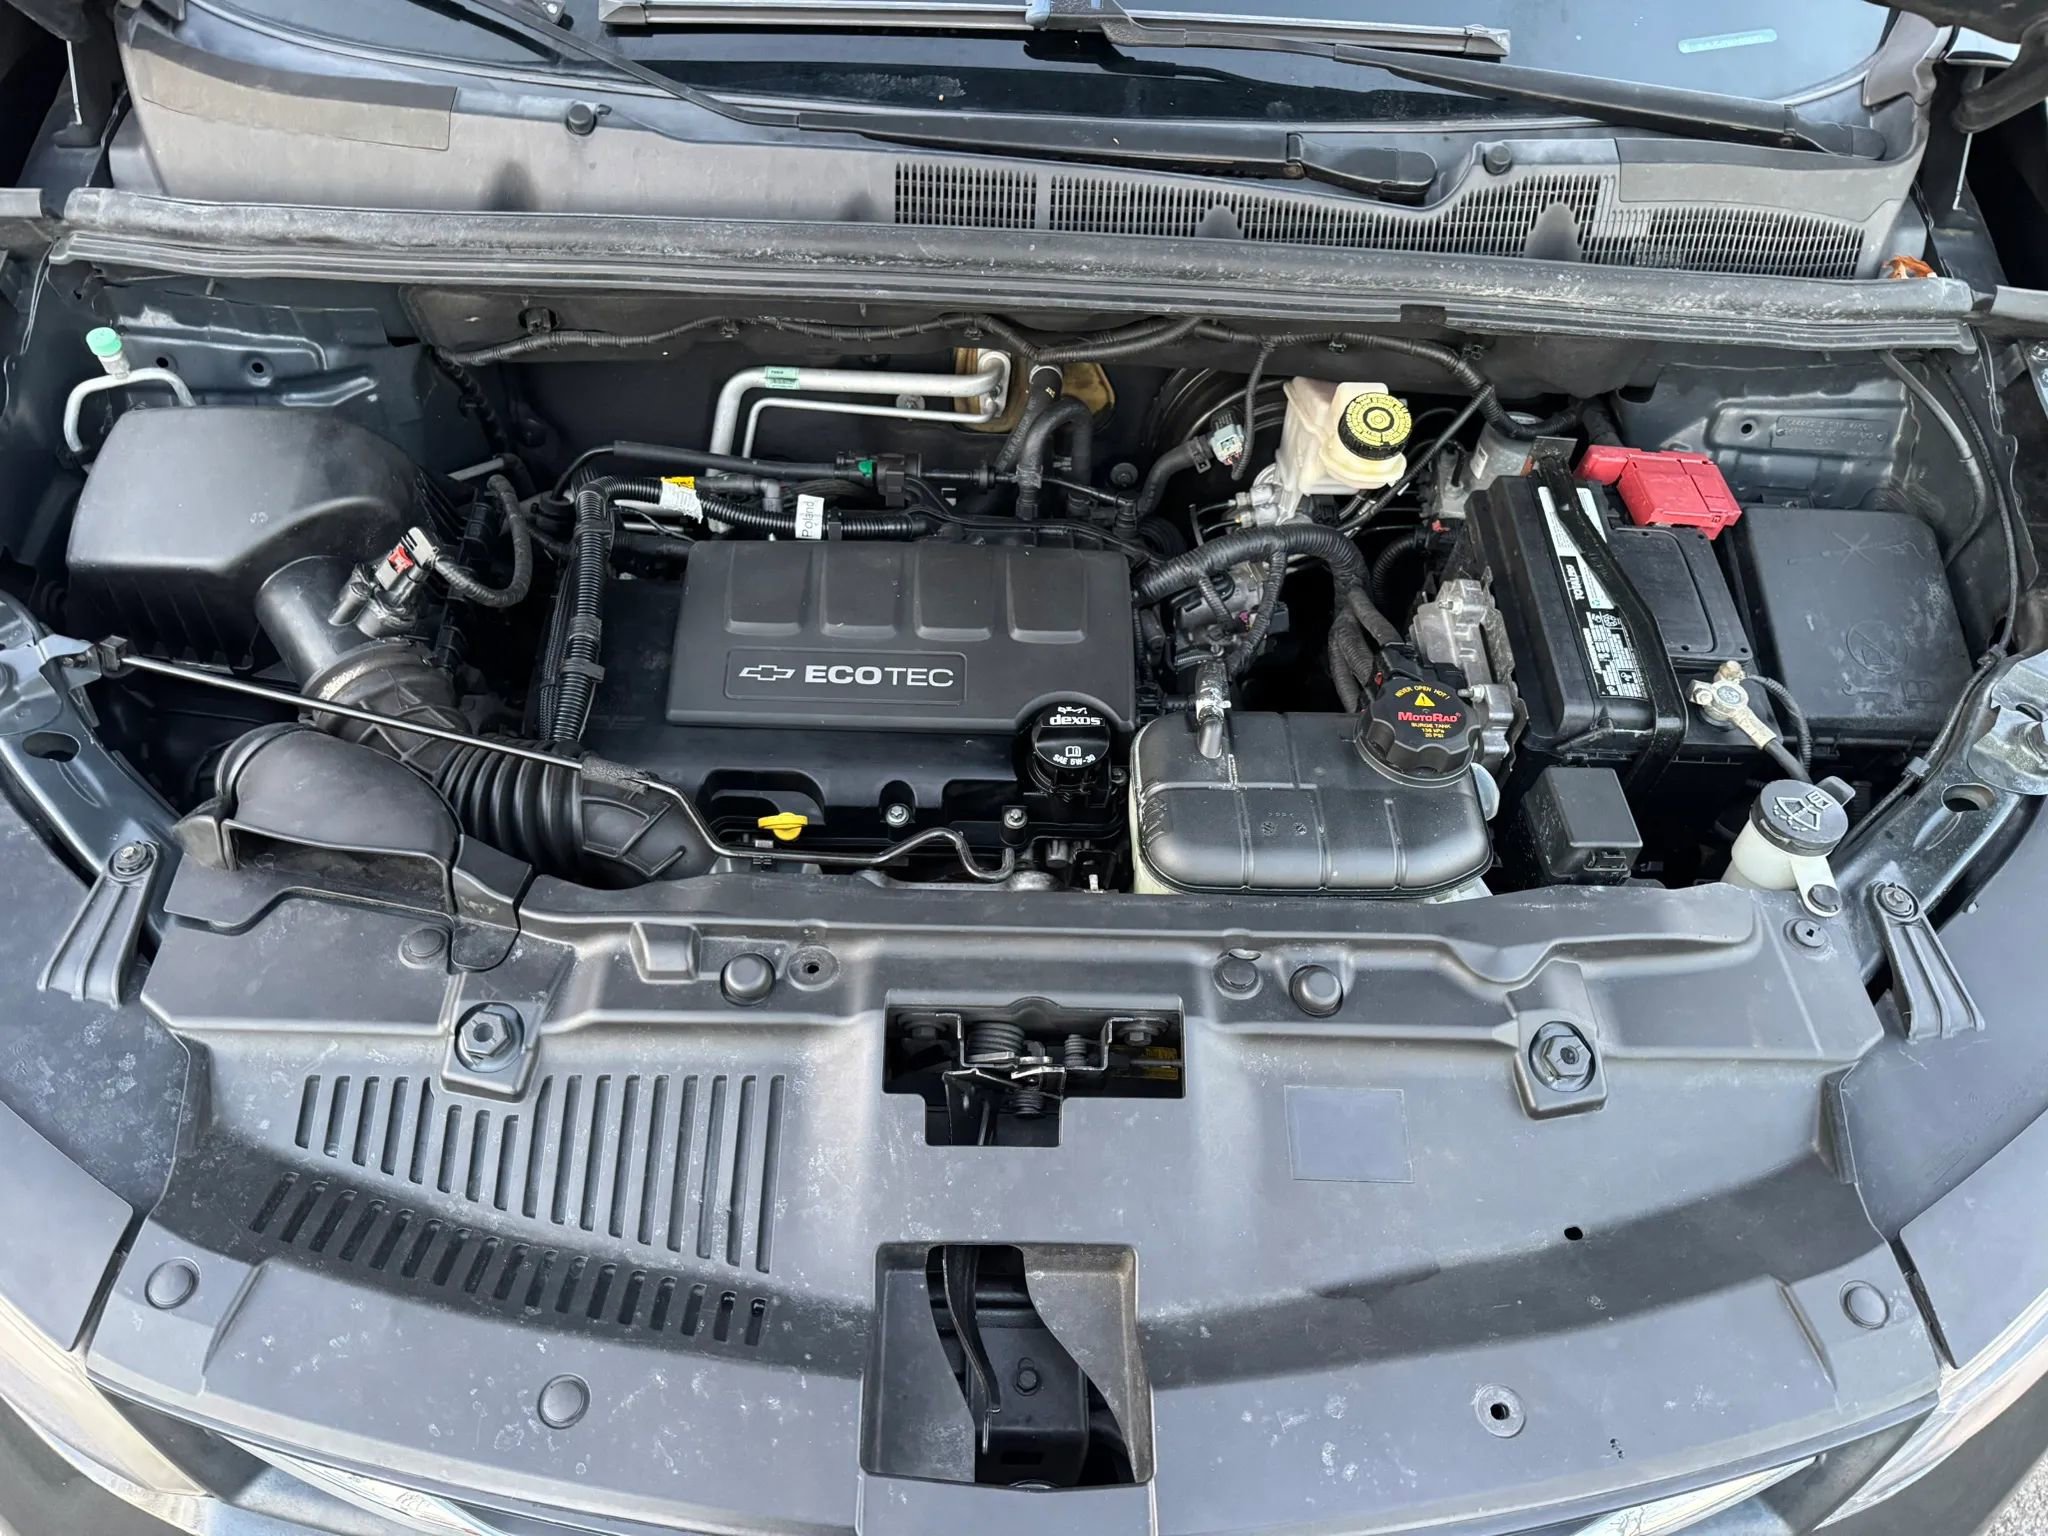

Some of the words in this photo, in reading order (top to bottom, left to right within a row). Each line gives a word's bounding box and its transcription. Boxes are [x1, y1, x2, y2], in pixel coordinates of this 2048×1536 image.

[801, 500, 815, 538] Poland
[804, 664, 954, 688] ECOTEC
[1050, 714, 1102, 725] dexos
[1053, 754, 1068, 764] SAE
[1070, 754, 1096, 765] 5W-30
